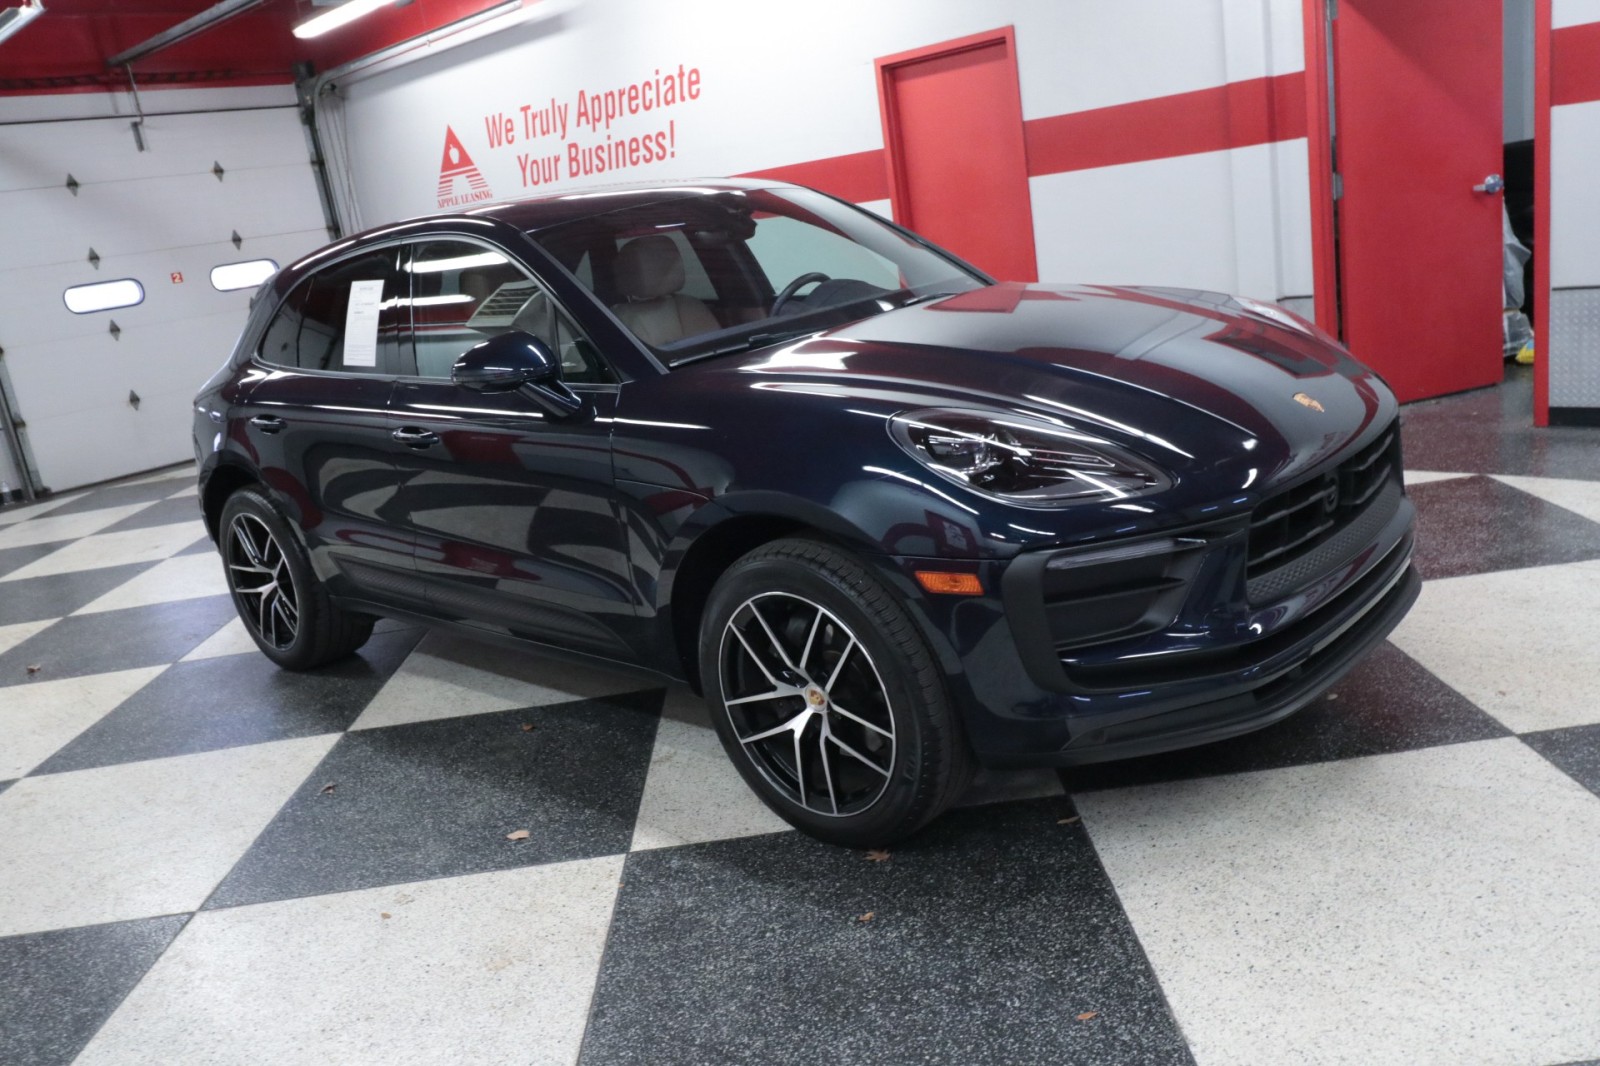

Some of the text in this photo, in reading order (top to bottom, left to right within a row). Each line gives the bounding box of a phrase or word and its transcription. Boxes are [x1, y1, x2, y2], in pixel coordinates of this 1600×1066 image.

[484, 64, 701, 149] We Truly Appreciate
[517, 119, 676, 188] Your Business!
[437, 190, 493, 209] APPLE LEASING
